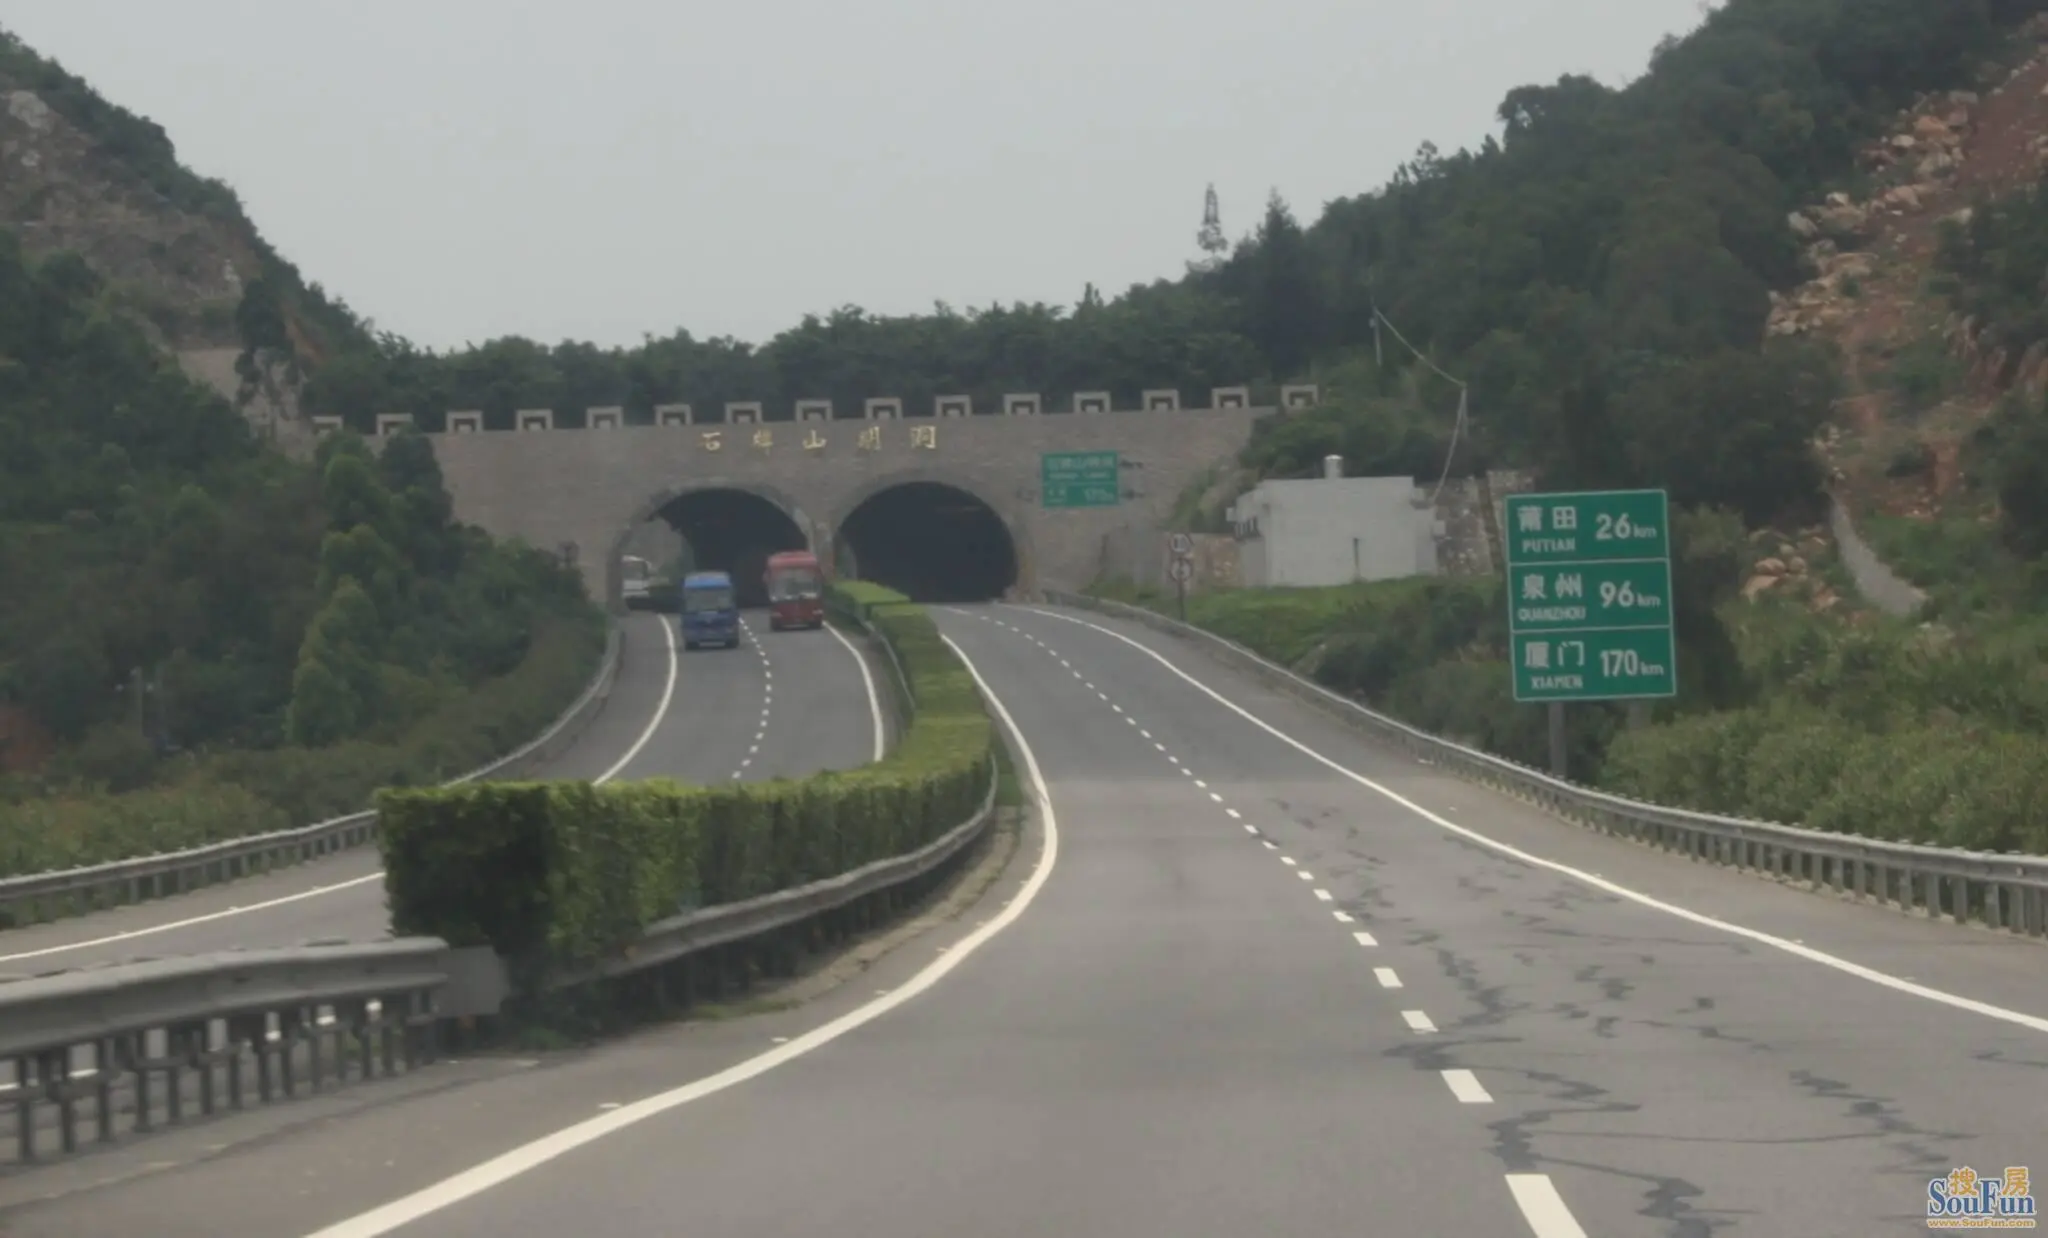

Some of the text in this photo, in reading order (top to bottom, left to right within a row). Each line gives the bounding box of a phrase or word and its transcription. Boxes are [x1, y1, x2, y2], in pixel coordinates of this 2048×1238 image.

[1517, 505, 1577, 532] 莆田
[1522, 538, 1576, 553] PUTIAN
[1522, 573, 1584, 600] 泉州
[1518, 606, 1586, 621] QUANZHOU
[1525, 641, 1585, 668] 厦门
[1531, 675, 1583, 690] XIAMEN
